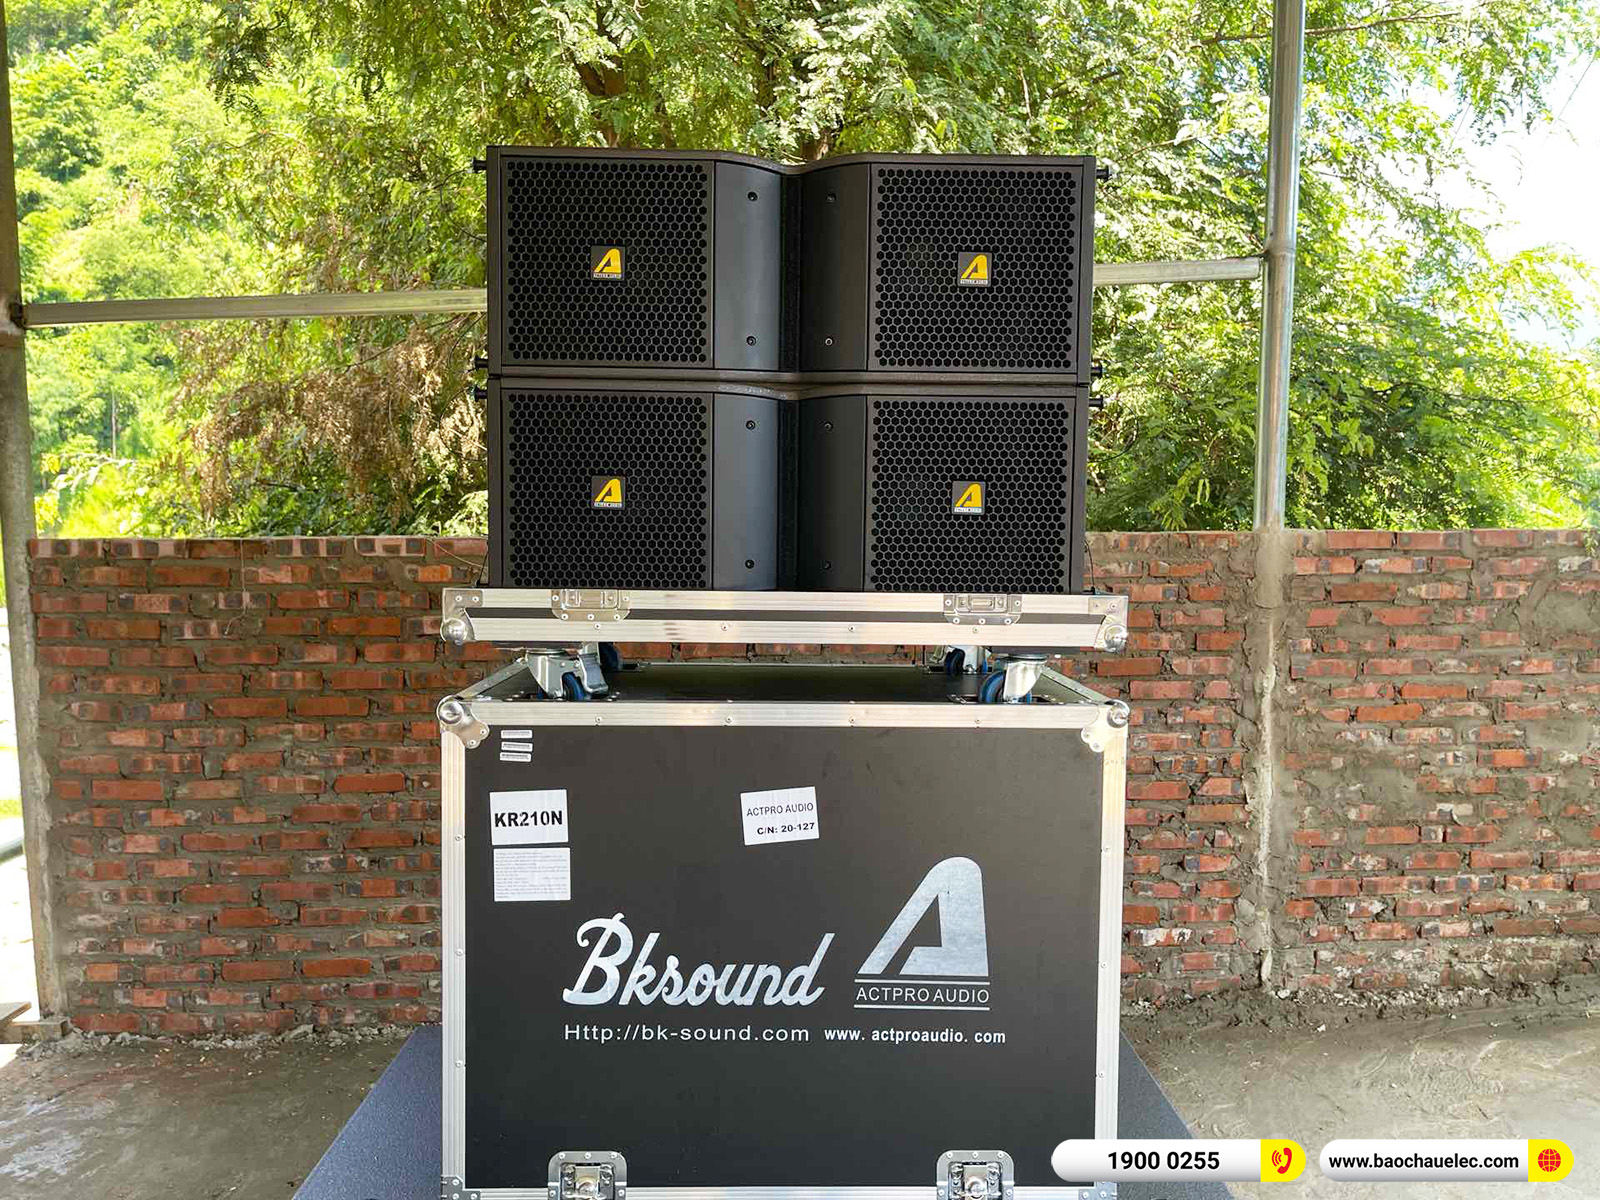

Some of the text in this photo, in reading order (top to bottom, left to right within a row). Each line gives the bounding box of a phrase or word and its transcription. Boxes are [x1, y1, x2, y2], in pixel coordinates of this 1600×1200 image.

[746, 802, 814, 817] ACTPRO AUDIO
[494, 810, 563, 828] KR210N
[756, 822, 815, 835] C/N: 20-127
[857, 856, 990, 977] A
[562, 912, 836, 1007] Bksound
[856, 986, 990, 1004] ACTPRO AUDIO
[564, 1024, 810, 1044] Http://bk-sound.com
